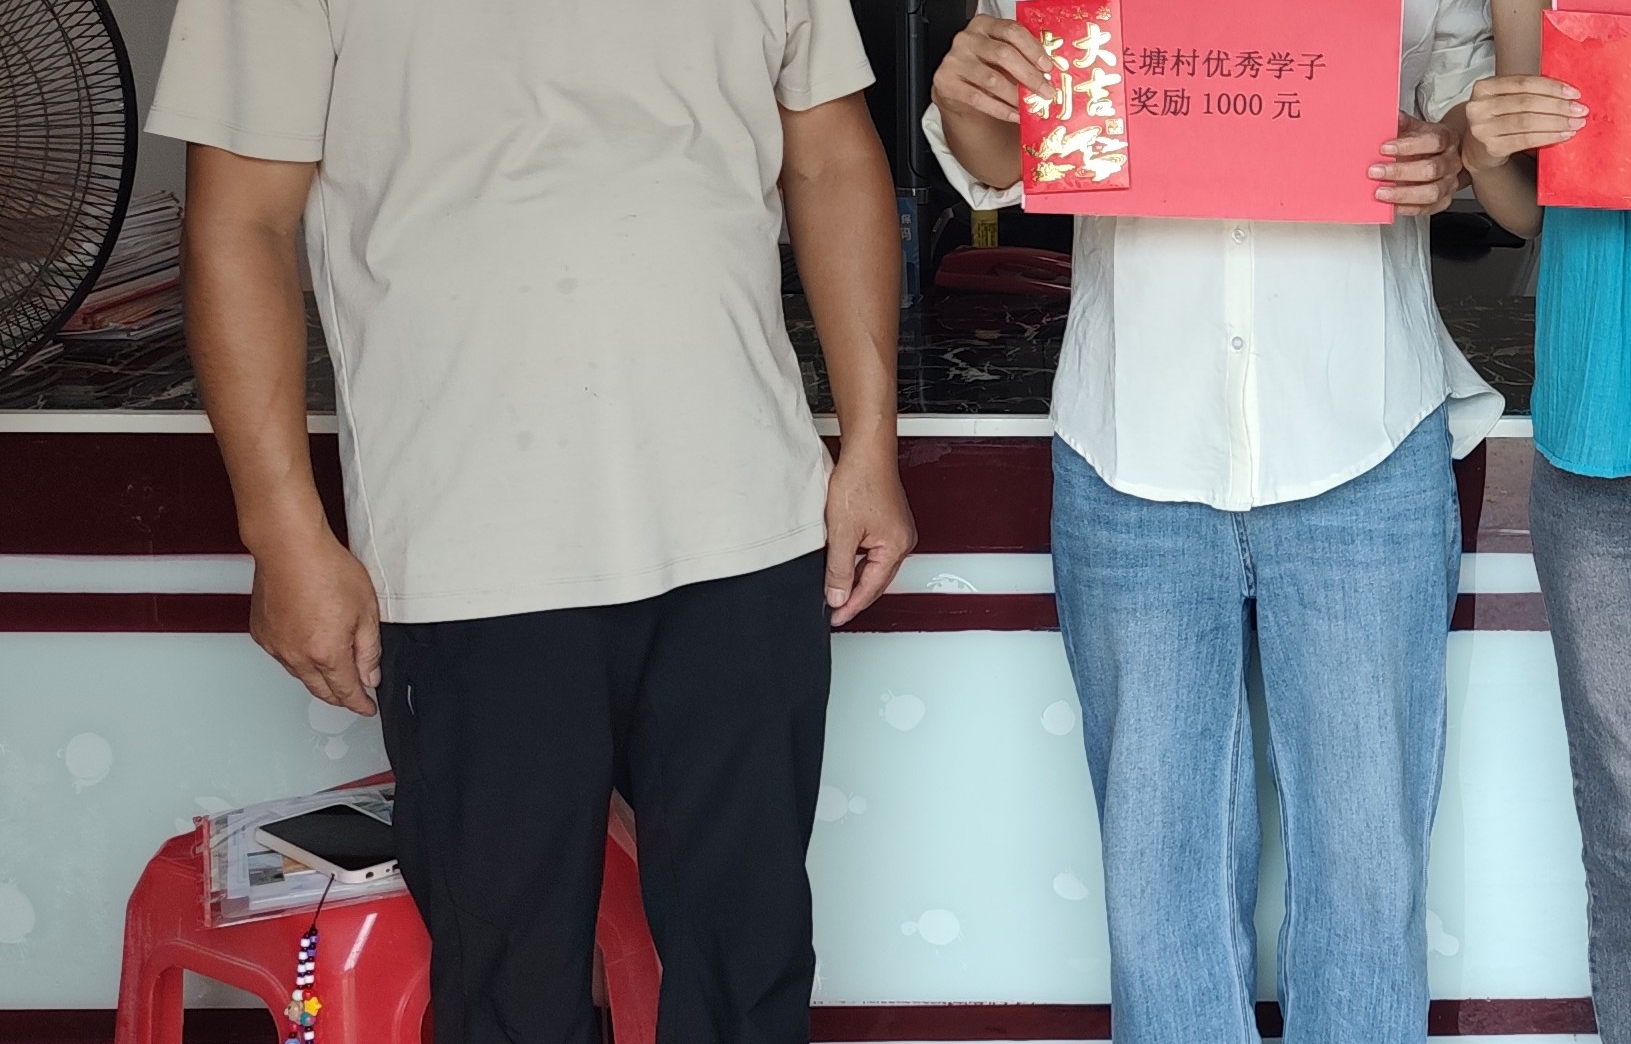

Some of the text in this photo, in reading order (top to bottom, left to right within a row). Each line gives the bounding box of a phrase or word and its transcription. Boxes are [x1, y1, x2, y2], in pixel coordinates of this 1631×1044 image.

[1071, 21, 1123, 118] 大吉
[1129, 86, 1303, 120] 奖励 1000 元
